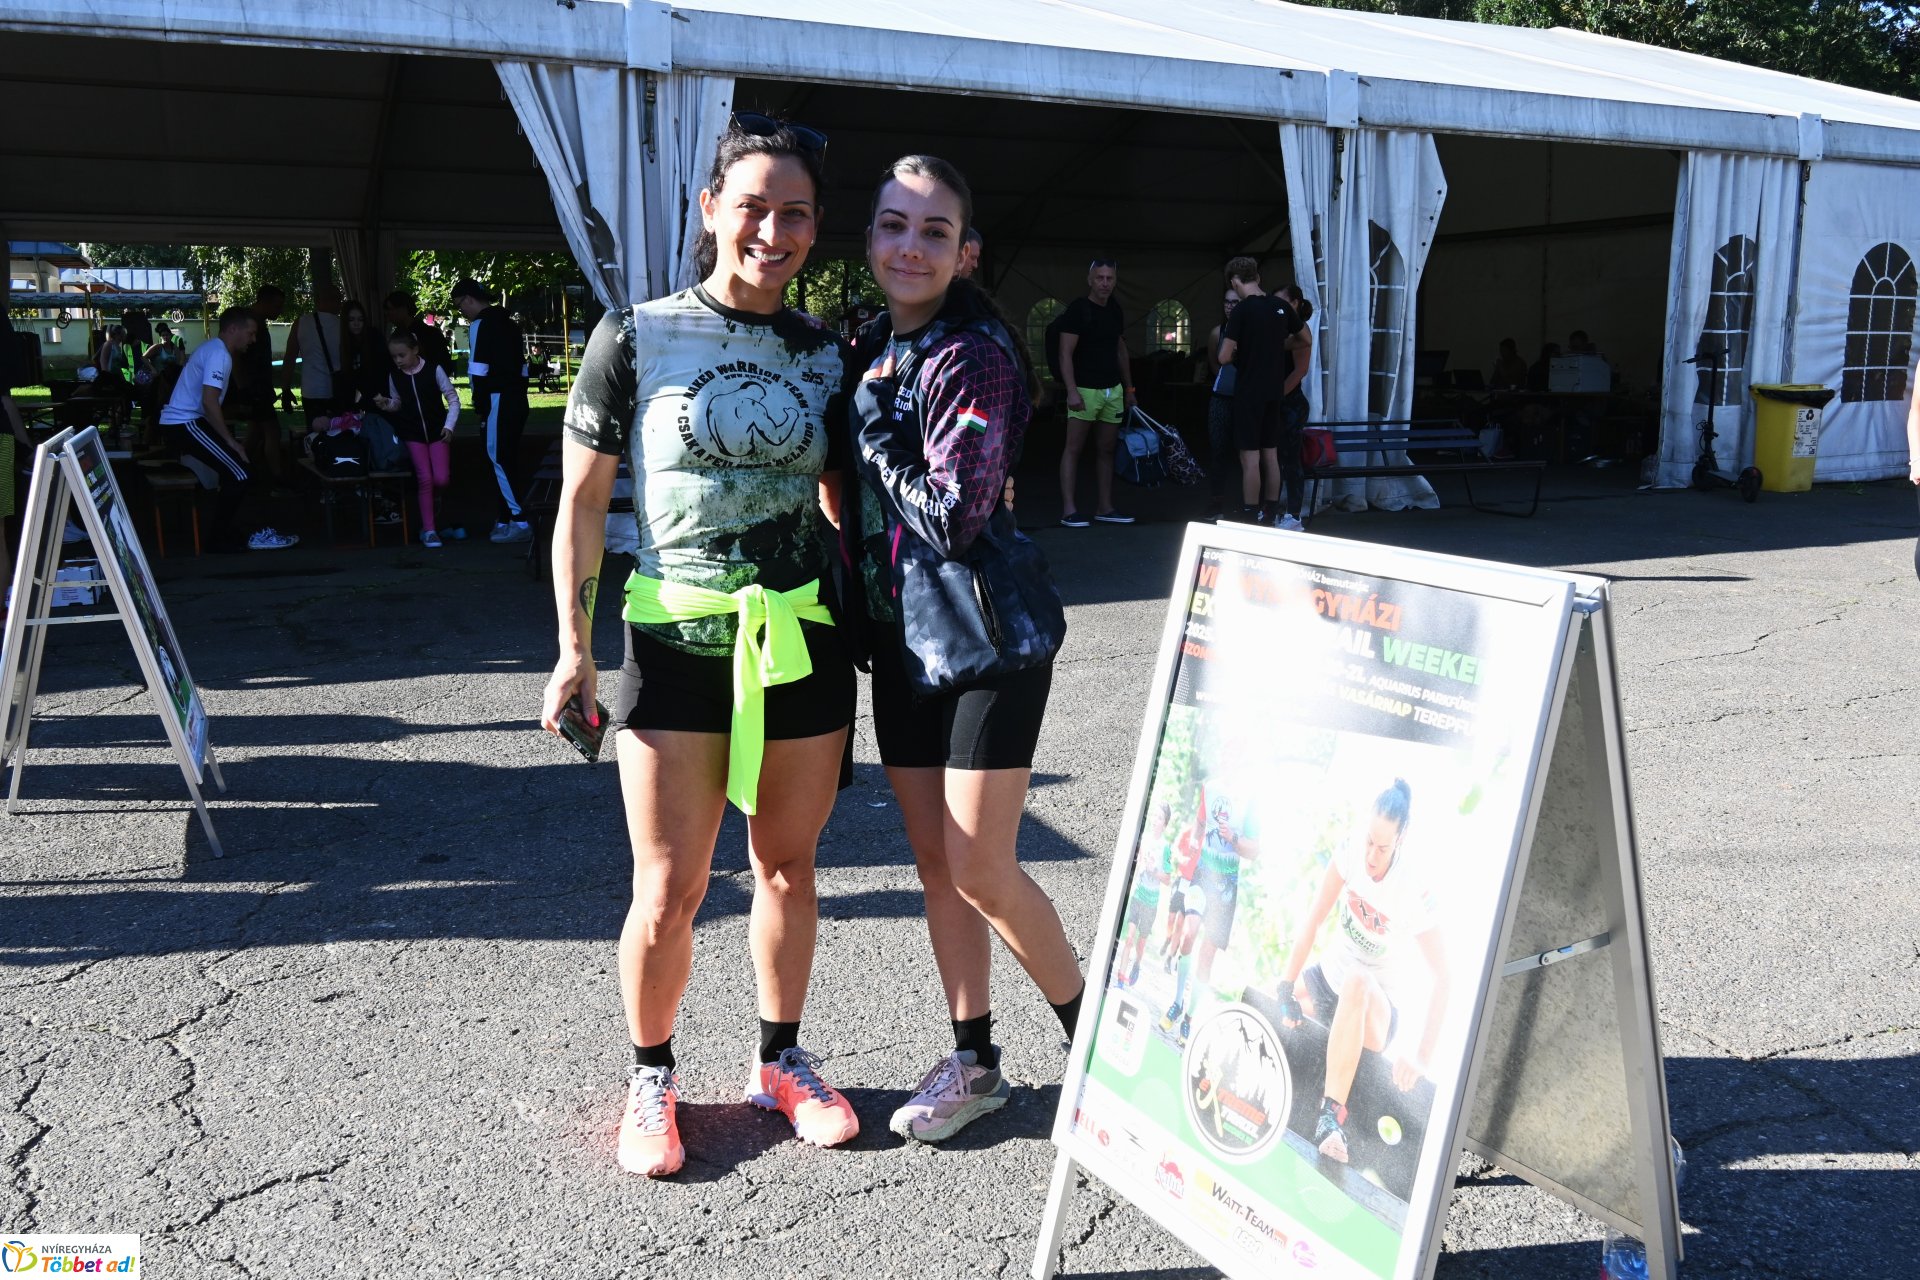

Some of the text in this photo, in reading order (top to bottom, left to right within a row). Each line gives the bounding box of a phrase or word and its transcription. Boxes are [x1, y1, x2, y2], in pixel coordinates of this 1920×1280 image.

[683, 360, 809, 409] NAKED WARRIOR TEAM
[677, 416, 699, 451] CSAK
[693, 445, 706, 458] A
[1368, 674, 1423, 699] AQUARIUS
